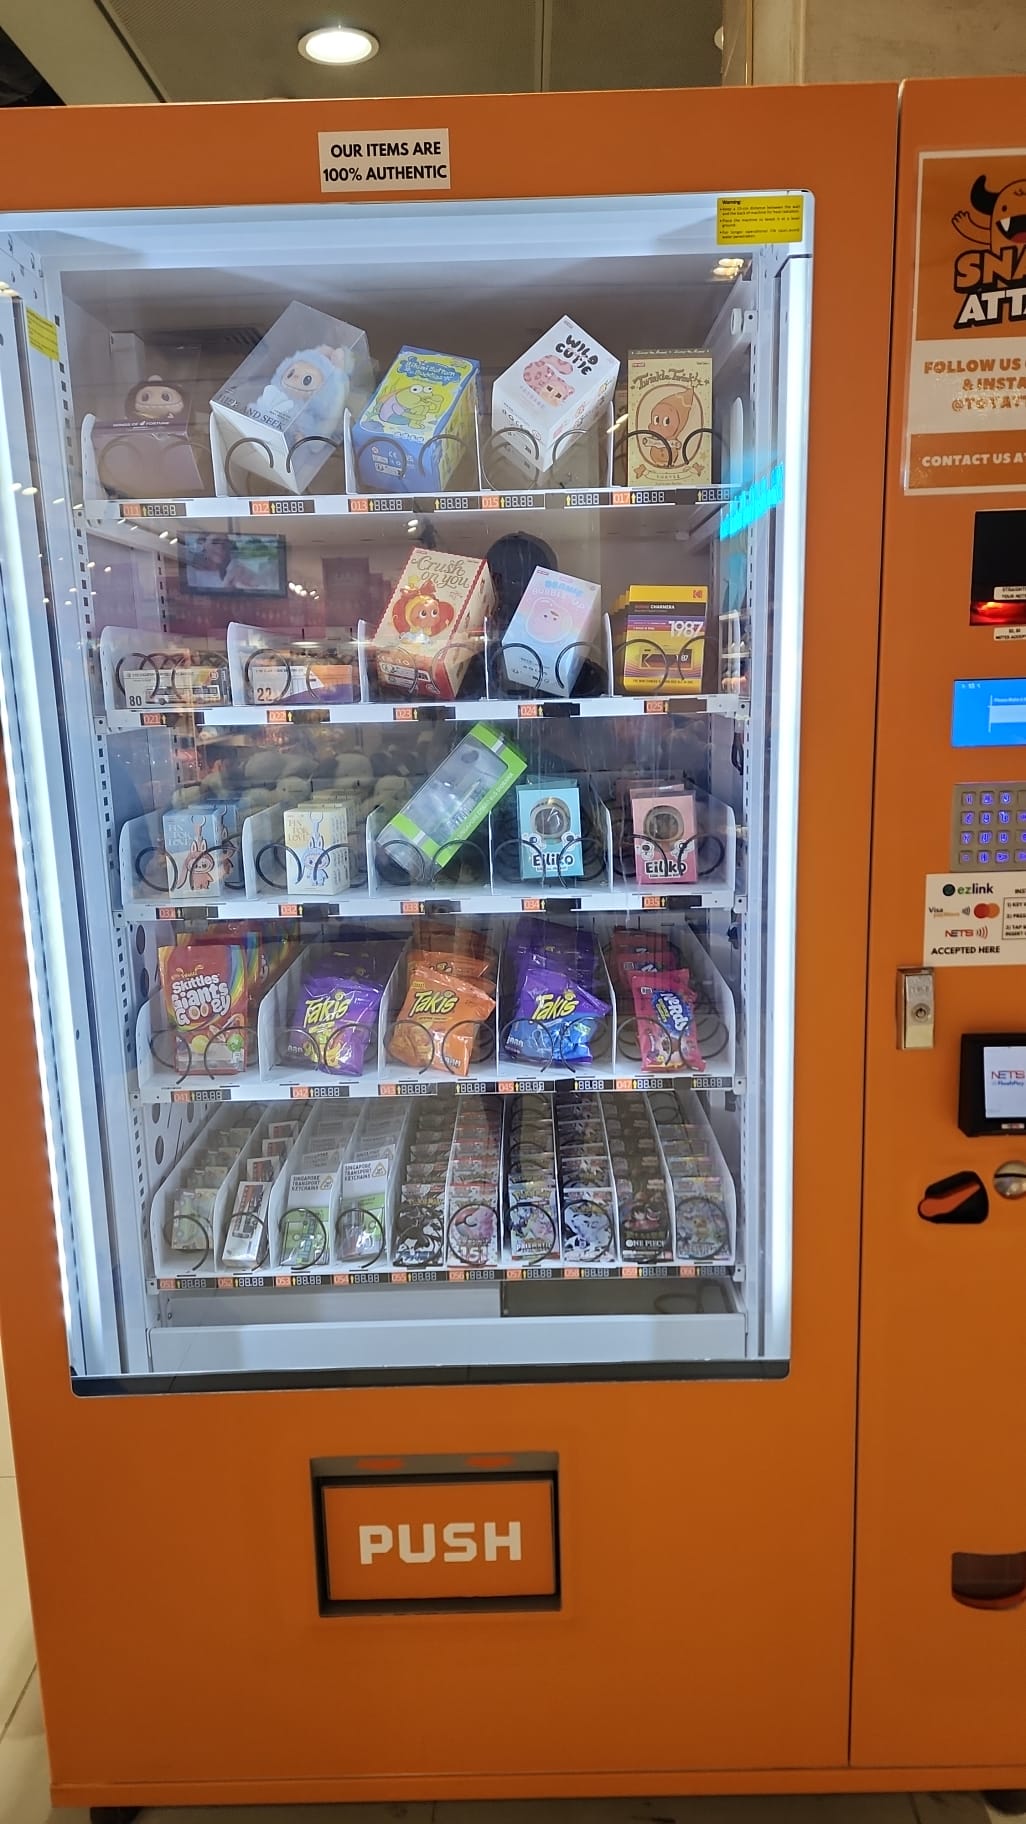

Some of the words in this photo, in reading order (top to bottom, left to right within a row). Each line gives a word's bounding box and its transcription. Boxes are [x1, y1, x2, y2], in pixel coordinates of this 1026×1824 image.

[331, 144, 363, 157] OUR
[366, 143, 409, 157] ITEMS
[412, 141, 441, 155] ARE
[323, 167, 362, 181] 100%
[366, 165, 447, 180] AUTHENTIC
[954, 286, 1026, 328] ATT
[565, 334, 599, 366] WILD
[555, 343, 592, 376] CUTIE
[924, 359, 995, 374] FOLLOW
[999, 358, 1021, 371] US
[261, 410, 285, 431] SEEK
[922, 454, 990, 467] CONTACT
[993, 452, 1011, 464] US
[351, 501, 367, 511] 013
[482, 500, 499, 509] 015
[614, 494, 630, 503] 017
[252, 503, 269, 513] 012
[412, 555, 467, 584] Crush
[421, 572, 438, 583] on
[438, 573, 469, 589] you
[668, 620, 704, 637] 1987
[129, 695, 142, 706] 80
[257, 687, 272, 701] 22
[645, 860, 687, 874] Eilko
[957, 882, 994, 895] ezlink
[945, 929, 974, 937] NETS
[931, 946, 976, 955] ACCEPTED
[979, 945, 1000, 954] HERE
[172, 974, 219, 994] Skittles
[171, 982, 229, 1011] Giants
[409, 990, 458, 1017] Takis
[175, 994, 231, 1026] Gooey
[303, 991, 350, 1028] Takis
[531, 989, 579, 1022] Takis
[991, 1070, 1025, 1080] NETS
[342, 1163, 371, 1171] SINGAPORE
[460, 1246, 487, 1262] 151
[359, 1521, 522, 1565] PUSH
